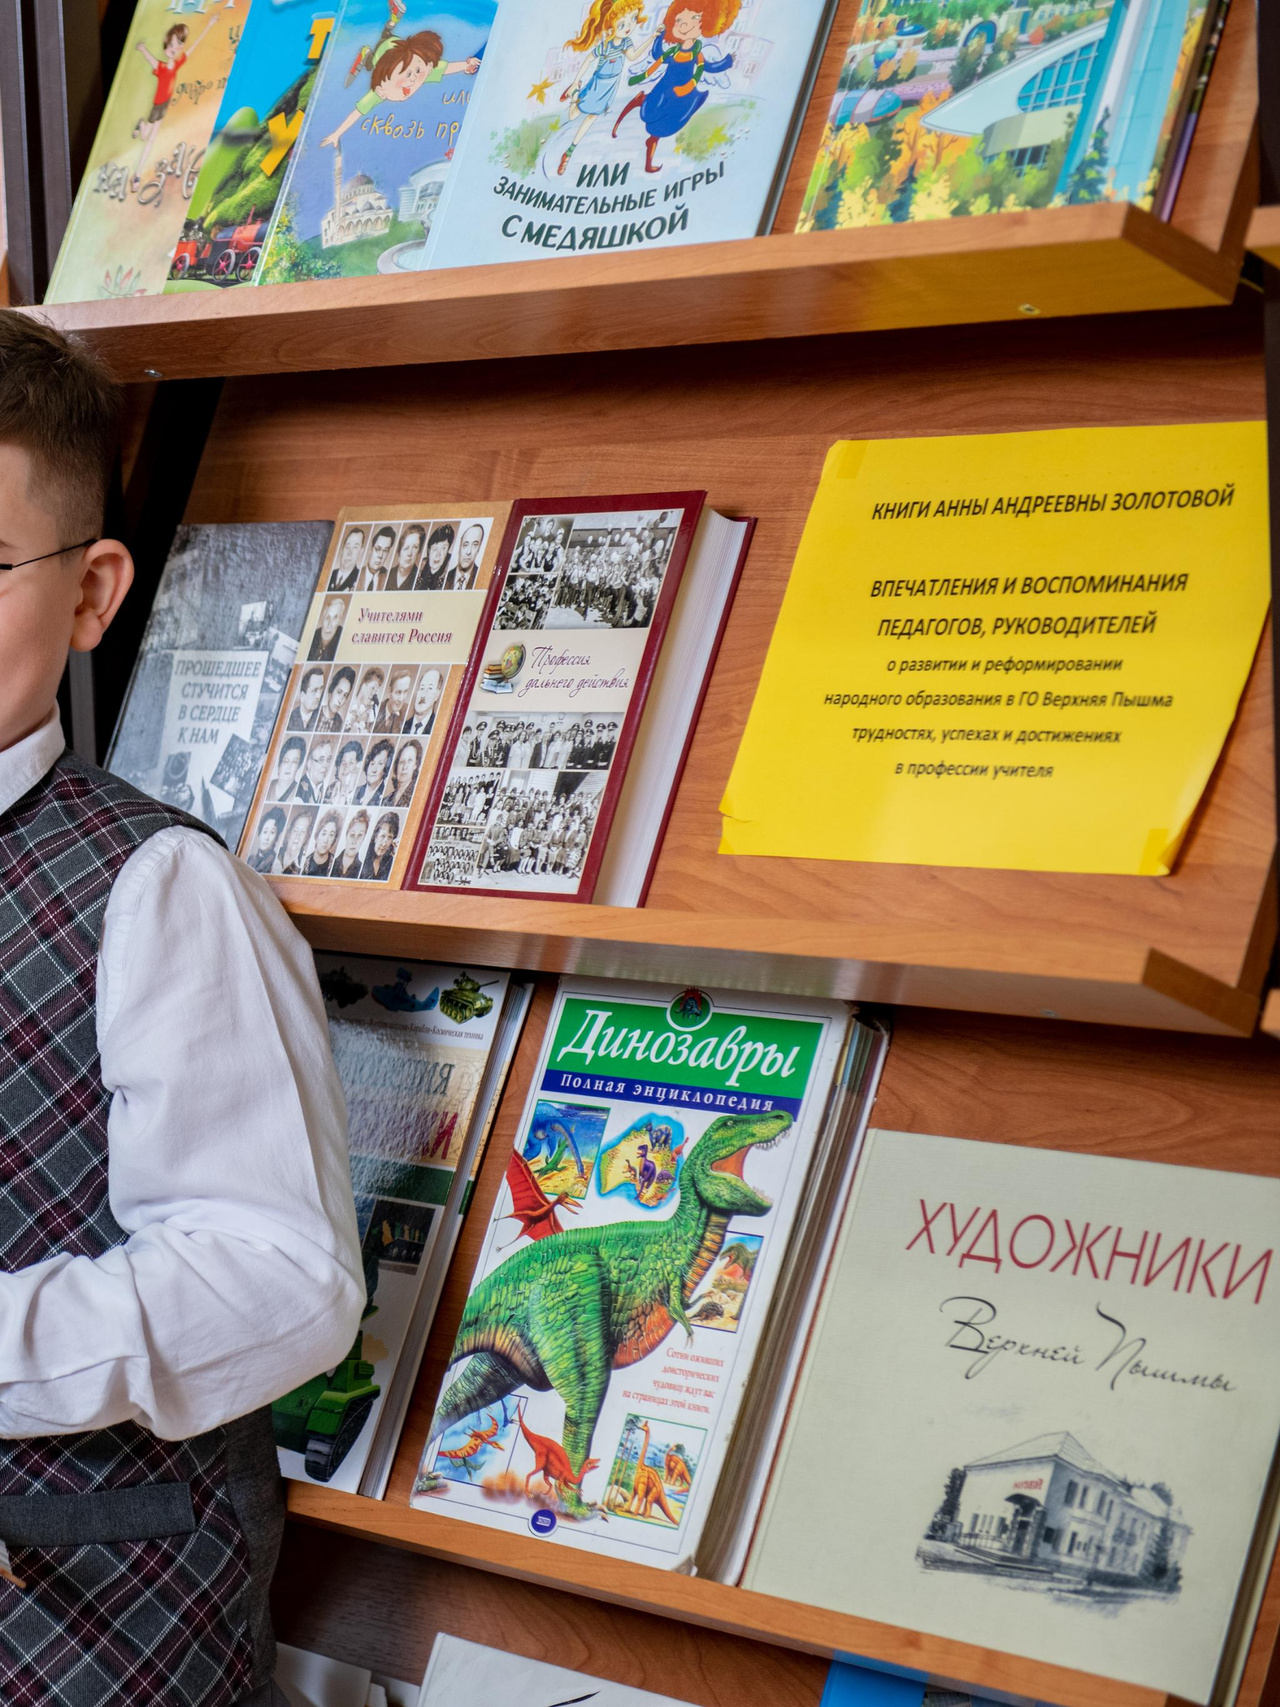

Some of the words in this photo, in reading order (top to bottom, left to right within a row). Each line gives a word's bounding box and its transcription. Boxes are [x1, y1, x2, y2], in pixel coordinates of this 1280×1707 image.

[361, 113, 425, 139] сквозь
[494, 176, 657, 215] ЗАНИМАТЕЛЬНЫЕ
[664, 161, 725, 202] ИГРЫ
[576, 162, 631, 188] ИЛИ
[501, 215, 523, 238] С
[521, 203, 690, 251] МЕДЯШКОЙ
[872, 500, 932, 520] КНИГИ
[933, 498, 988, 518] АННЫ
[991, 494, 1108, 518] АНДРЕЕВНЫ
[1111, 483, 1235, 511] ЗОЛОТОВОЙ
[870, 578, 999, 598] ВПЕЧАТЛЕНИЯ
[1002, 577, 1018, 595] И
[1020, 573, 1189, 595] ВОСПОМИНАНИЯ
[358, 607, 424, 623] Учителями
[877, 617, 988, 640] ПЕДАГОГОВ,
[992, 610, 1157, 638] РУКОВОДИТЕЛЕЙ
[351, 632, 405, 643] славится
[408, 628, 452, 643] Россия
[174, 660, 262, 678] ПРОШЕДШЕЕ
[531, 645, 591, 675] Профессия
[887, 660, 896, 671] о
[899, 660, 968, 675] развитии
[970, 660, 981, 671] и
[984, 656, 1123, 675] реформировании
[181, 682, 249, 700] СТУЧИТСЯ
[518, 678, 575, 698] дальнего
[569, 668, 630, 698] действия
[824, 692, 902, 708] народного
[906, 690, 1002, 709] образования
[1006, 694, 1015, 706] в
[1018, 691, 1039, 706] ГО
[1042, 691, 1108, 709] Верхняя
[1111, 691, 1173, 707] Пышма
[178, 704, 188, 720] В
[190, 704, 241, 723] СЕРДЦЕ
[177, 727, 188, 744] К
[189, 728, 220, 744] НАМ
[852, 727, 937, 743] трудностях,
[941, 729, 998, 743] успехах
[1001, 730, 1012, 741] и
[1015, 730, 1122, 744] достижениях
[895, 762, 903, 774] в
[907, 760, 988, 778] профессии
[992, 764, 1054, 780] учителя
[556, 1009, 802, 1088] Динозавры
[560, 1073, 625, 1094] Полная
[633, 1084, 775, 1112] энциклопедия
[905, 1199, 1274, 1305] ХУДОЖНИКИ
[939, 1296, 1087, 1379] Верхней
[1096, 1301, 1238, 1391] Пышмы
